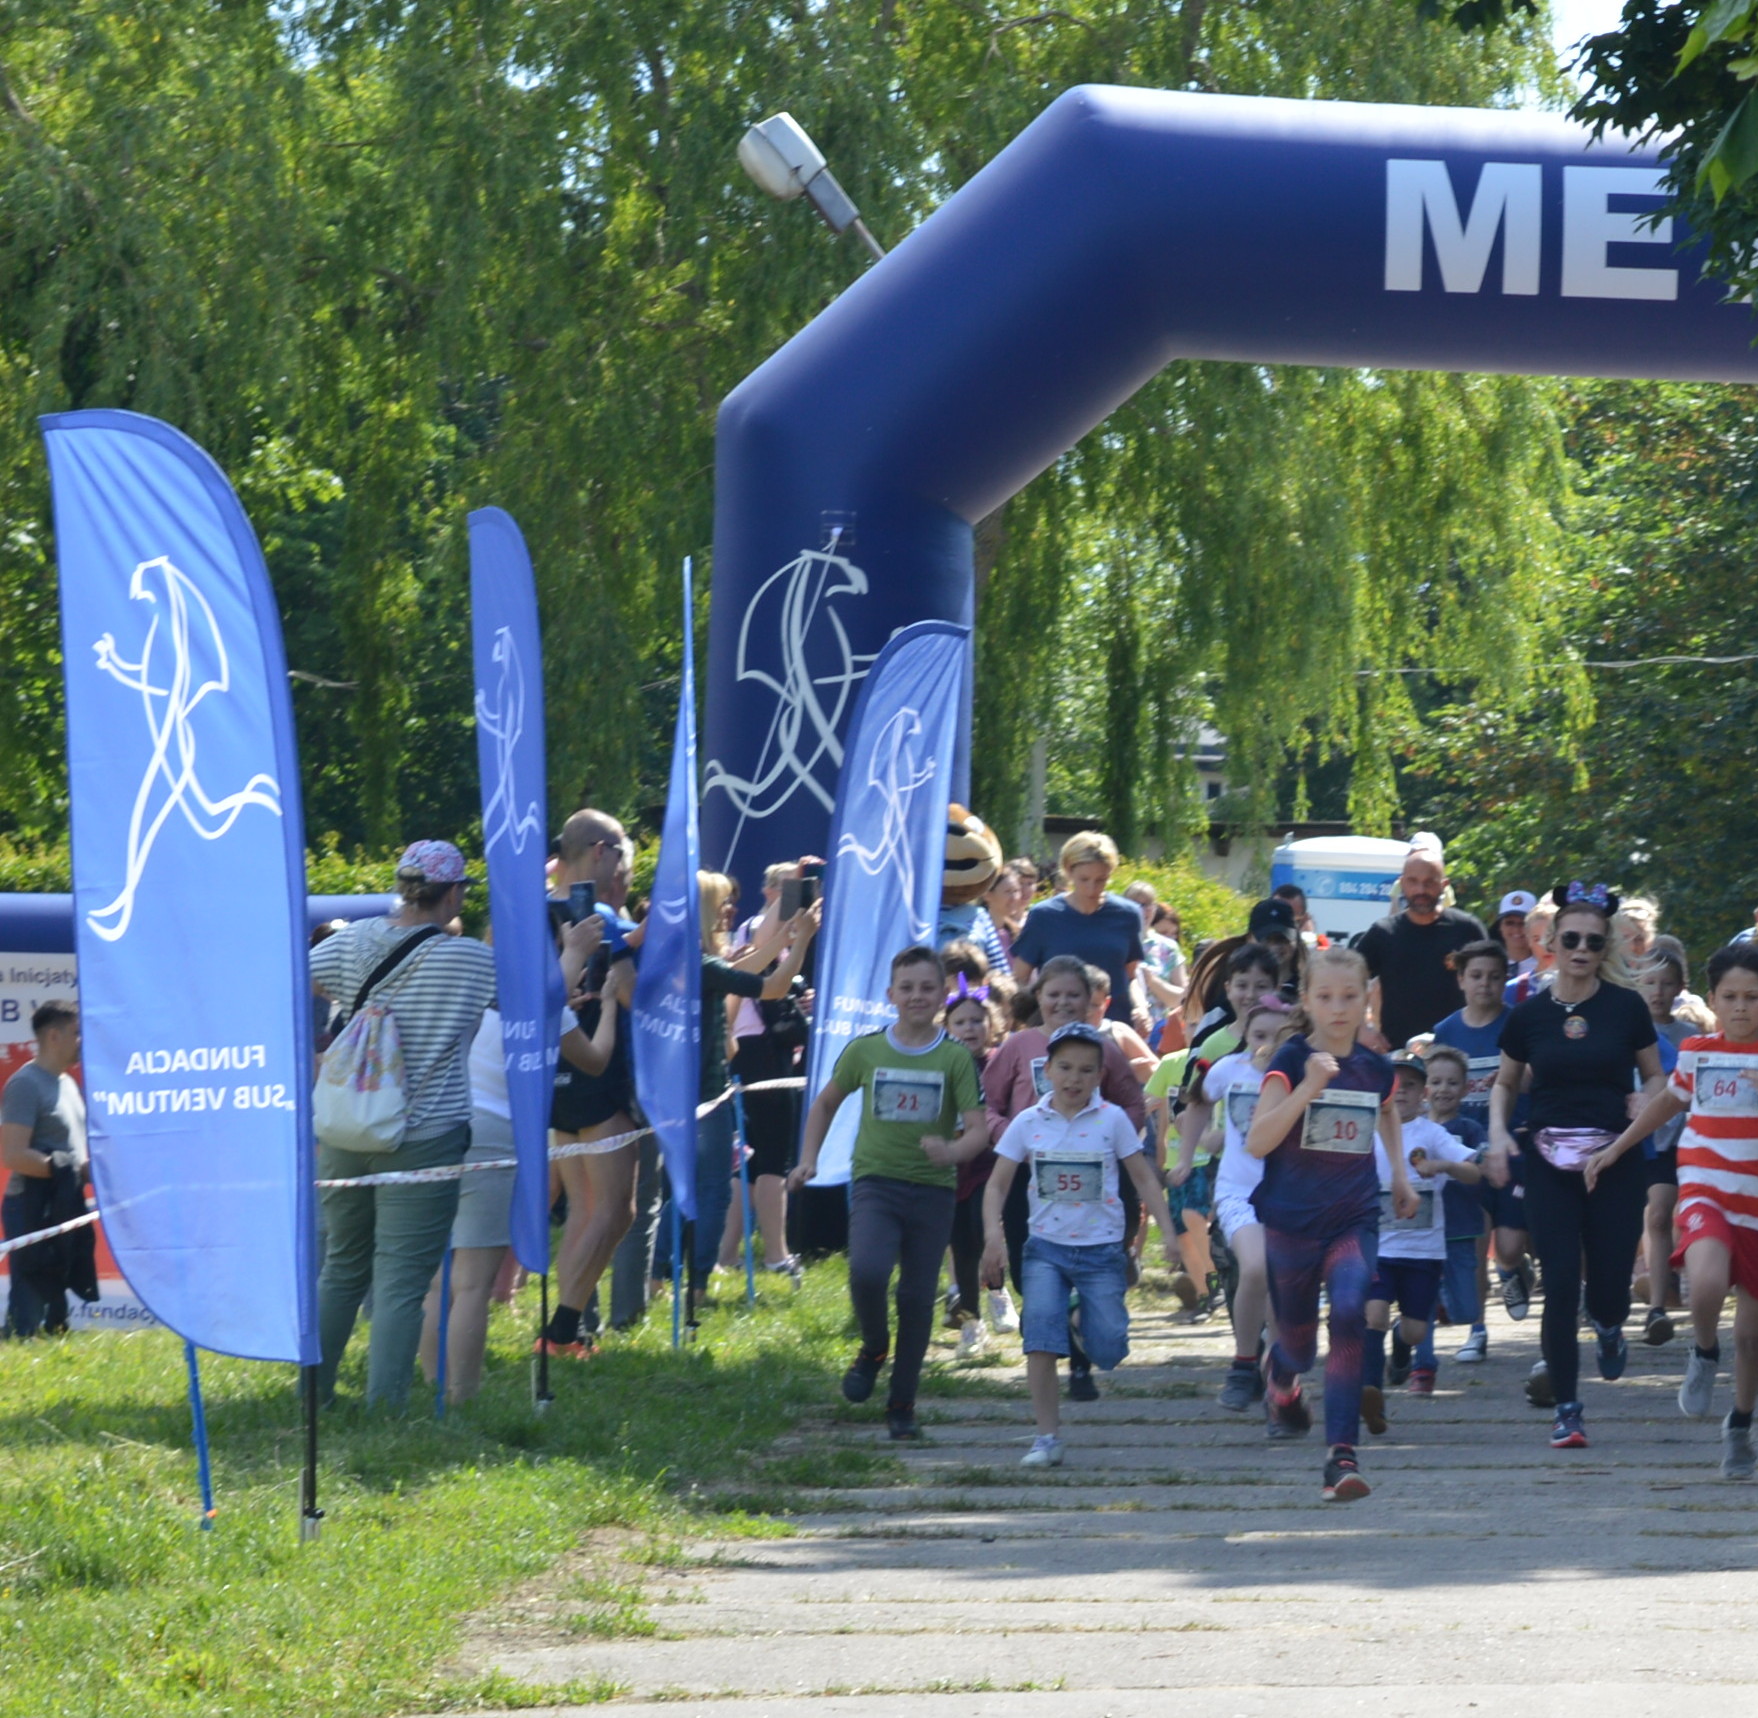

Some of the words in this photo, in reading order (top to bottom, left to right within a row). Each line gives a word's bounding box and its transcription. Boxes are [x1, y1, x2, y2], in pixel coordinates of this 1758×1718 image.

[1713, 1080, 1737, 1097] 64
[897, 1093, 919, 1111] 21
[1334, 1120, 1358, 1140] 10
[1057, 1174, 1082, 1191] 55
